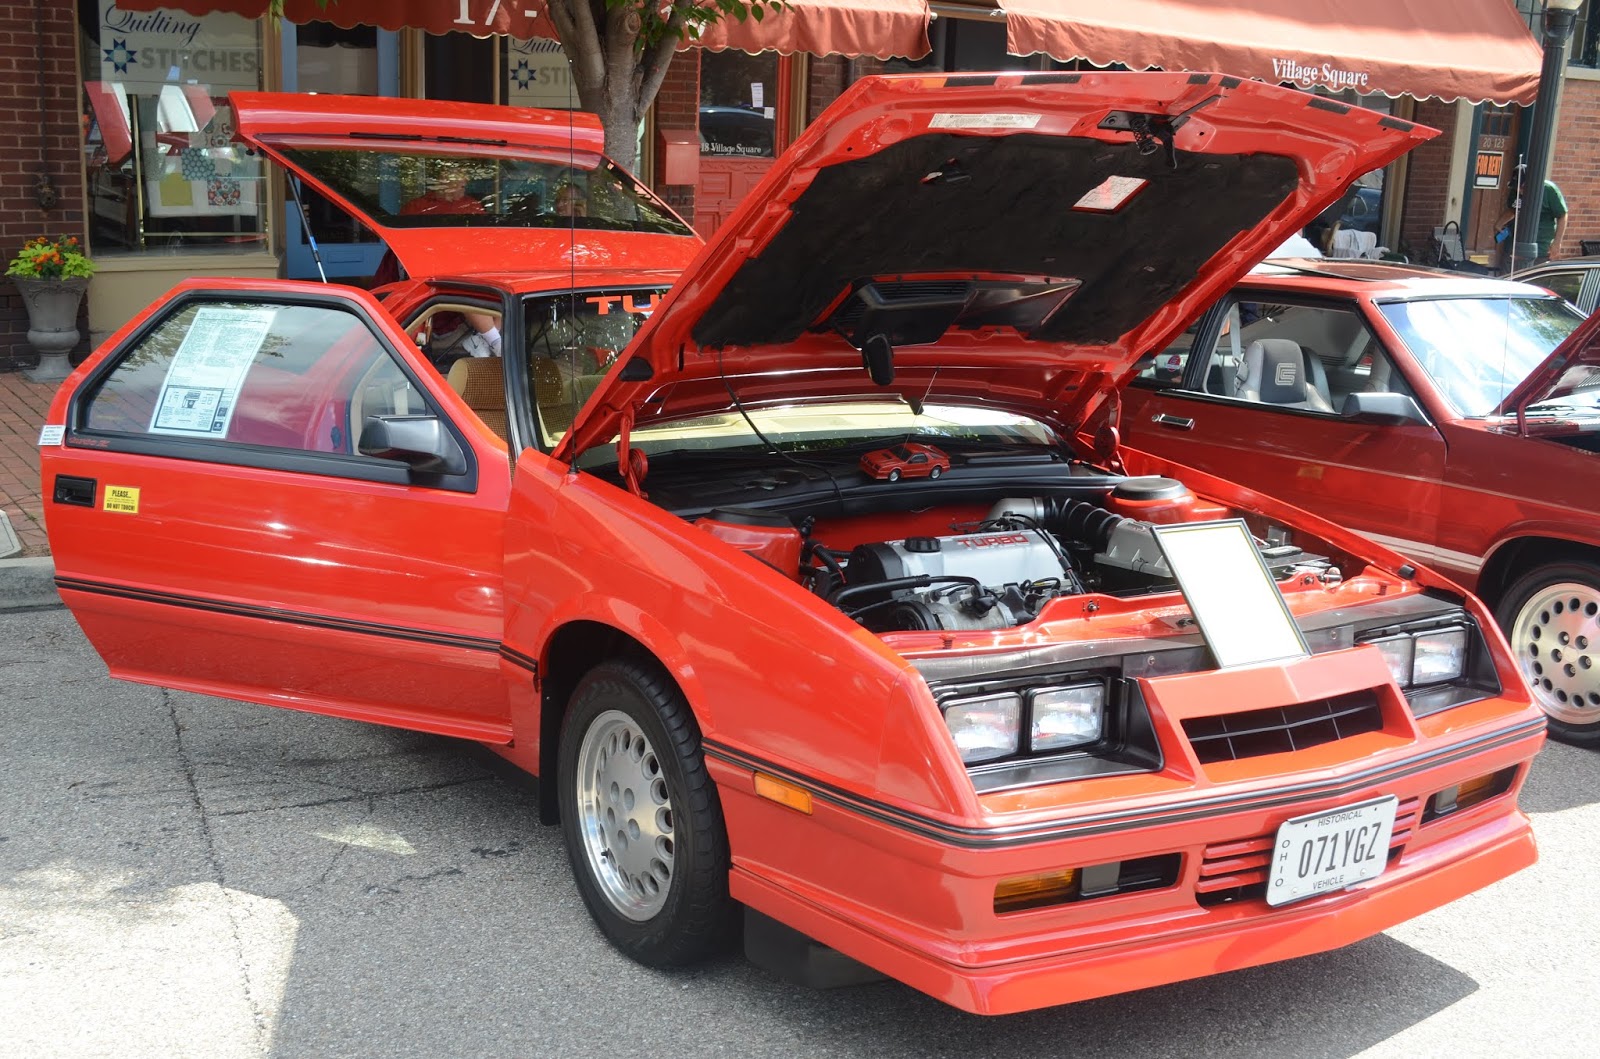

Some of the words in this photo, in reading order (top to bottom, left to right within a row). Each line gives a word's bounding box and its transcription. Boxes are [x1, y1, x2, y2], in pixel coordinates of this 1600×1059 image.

[101, 4, 201, 48] Quilting
[141, 48, 257, 72] STITCHES
[1272, 58, 1318, 85] Village
[1321, 63, 1368, 88] Square
[711, 143, 735, 155] Village
[736, 144, 762, 155] Square
[1475, 154, 1489, 175] FOR
[1487, 155, 1503, 176] RENT
[957, 534, 1029, 547] TURBO
[1317, 811, 1362, 827] HISTORICAL
[1298, 821, 1382, 878] 071YGZ
[1275, 839, 1291, 887] OHIO
[1312, 874, 1345, 890] VEHICLE
